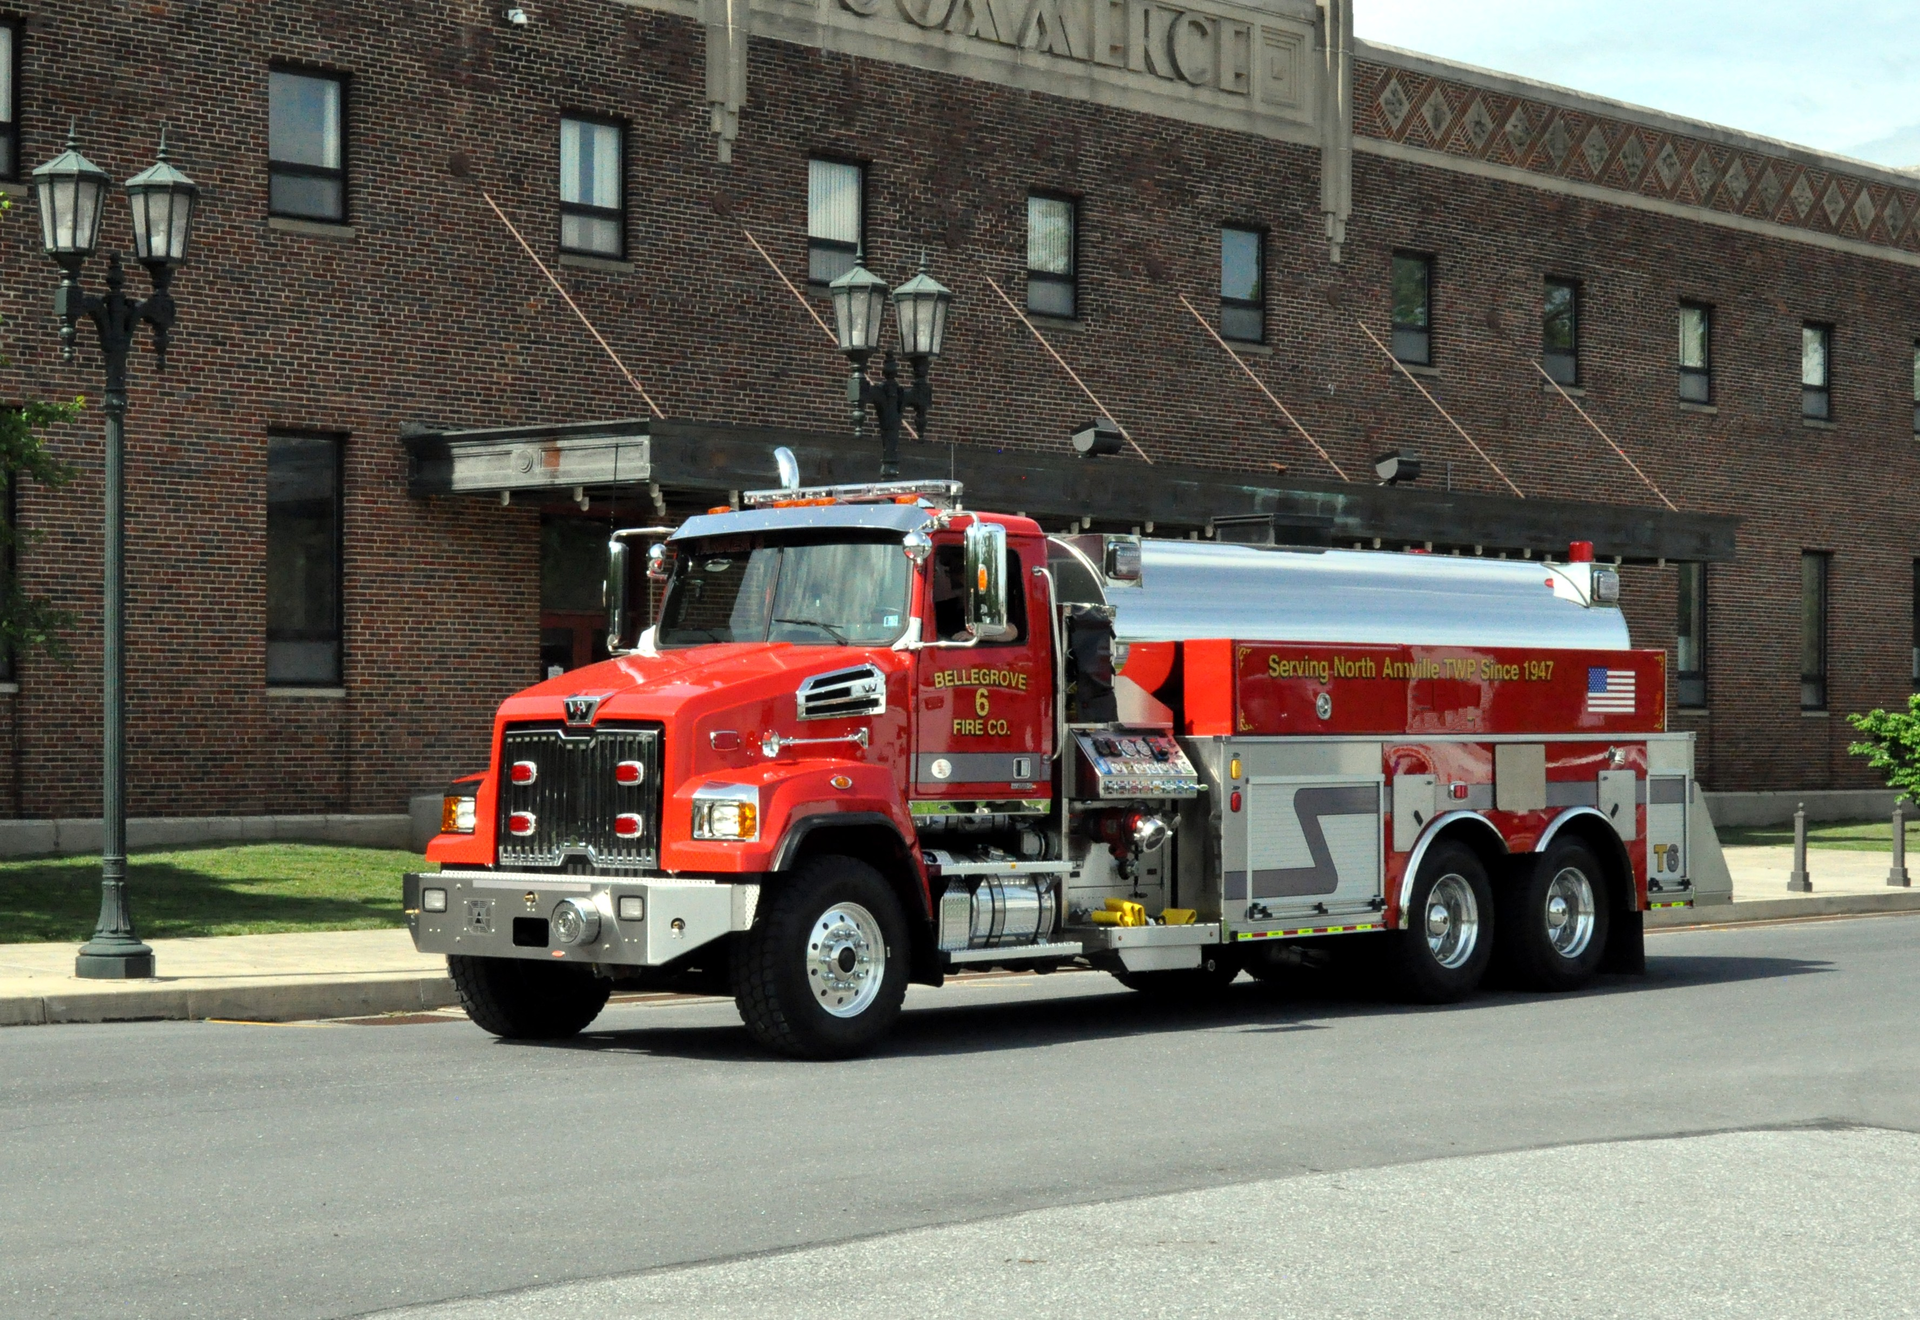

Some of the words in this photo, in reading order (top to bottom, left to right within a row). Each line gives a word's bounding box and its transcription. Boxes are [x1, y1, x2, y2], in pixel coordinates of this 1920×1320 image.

[934, 668, 1027, 690] BELLEGROVE
[1268, 654, 1329, 683] Serving
[1333, 656, 1376, 678] North
[1443, 658, 1477, 679] TWP
[1480, 659, 1519, 680] Since
[1523, 660, 1554, 680] 1947
[975, 687, 989, 717] 6
[953, 719, 984, 735] FIRE
[987, 719, 1011, 735] CO.
[1653, 843, 1680, 873] T6
